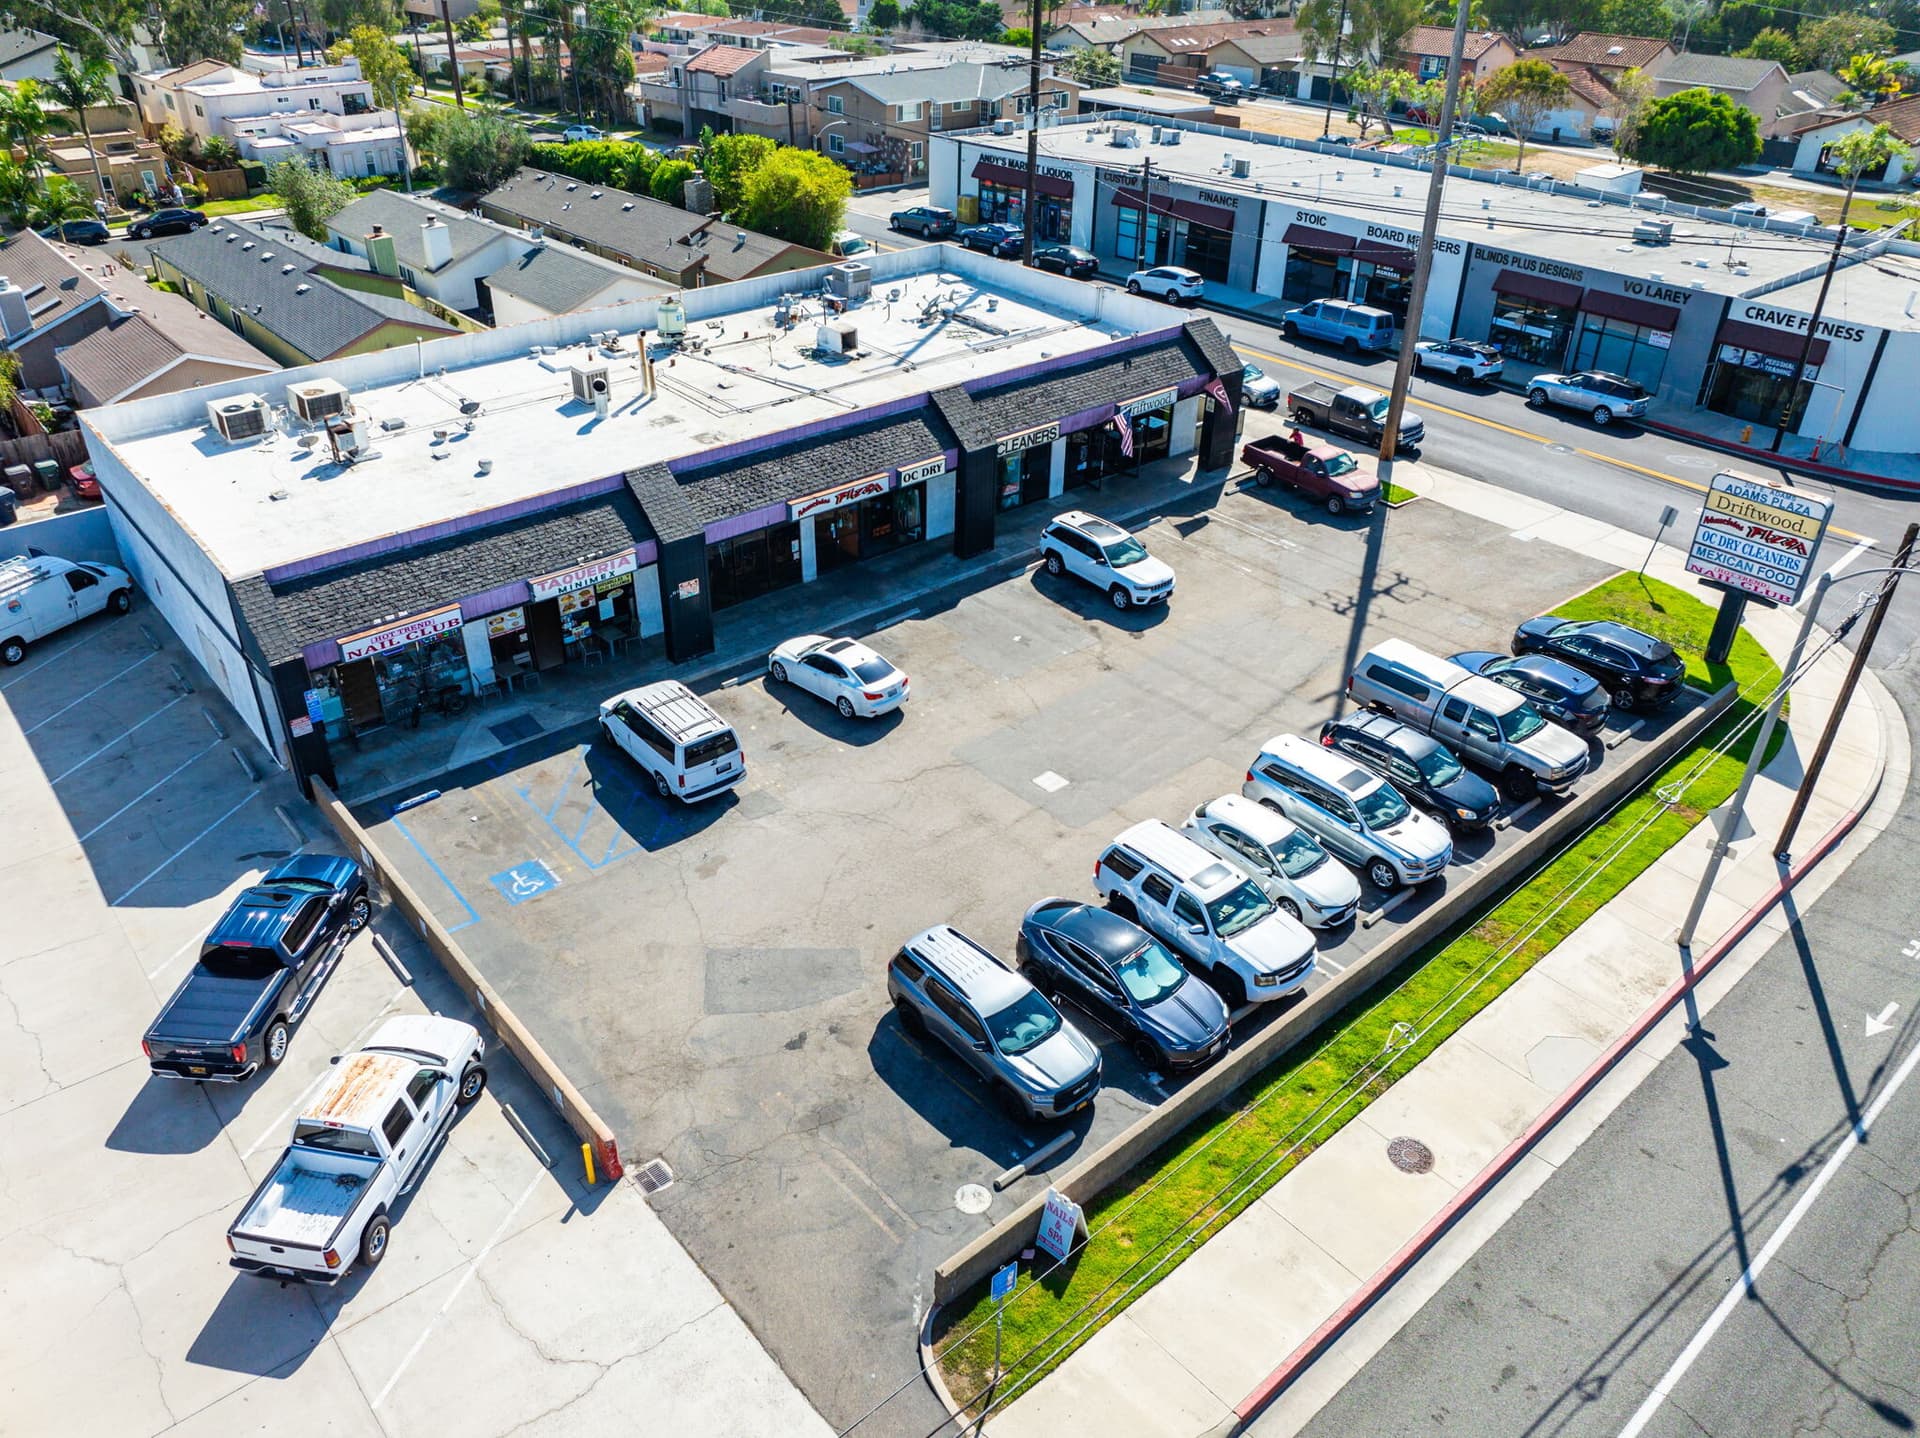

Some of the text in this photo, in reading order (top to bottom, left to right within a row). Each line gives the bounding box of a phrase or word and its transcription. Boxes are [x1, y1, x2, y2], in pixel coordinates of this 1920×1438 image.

[979, 153, 1073, 180] ANDY'S MART LIQUOR
[1199, 191, 1239, 208] FINANCE
[1296, 211, 1327, 226] STOIC
[1367, 225, 1461, 255] BOARD MEBERS
[1475, 248, 1584, 281] BLINDS PLUS DESIGNS
[1624, 280, 1693, 305] VO LAREY
[1745, 306, 1865, 342] CRAVE FTNESS
[997, 427, 1057, 455] CLEANERS
[903, 462, 943, 483] OC DRY
[1725, 484, 1811, 516] ADAMS PLAZA
[1702, 530, 1800, 571] OC DRY CLEANERS
[537, 556, 631, 592] TAQUERIA
[1696, 546, 1796, 586] MEXICAN FOOD
[558, 570, 616, 594] MINIMEX
[1690, 564, 1791, 603] NAIL CLUB
[346, 639, 401, 660] NAIL
[405, 617, 461, 641] CLUB
[1047, 1201, 1074, 1227] NAILS
[1055, 1219, 1061, 1231] &
[1047, 1227, 1063, 1244] SPA
